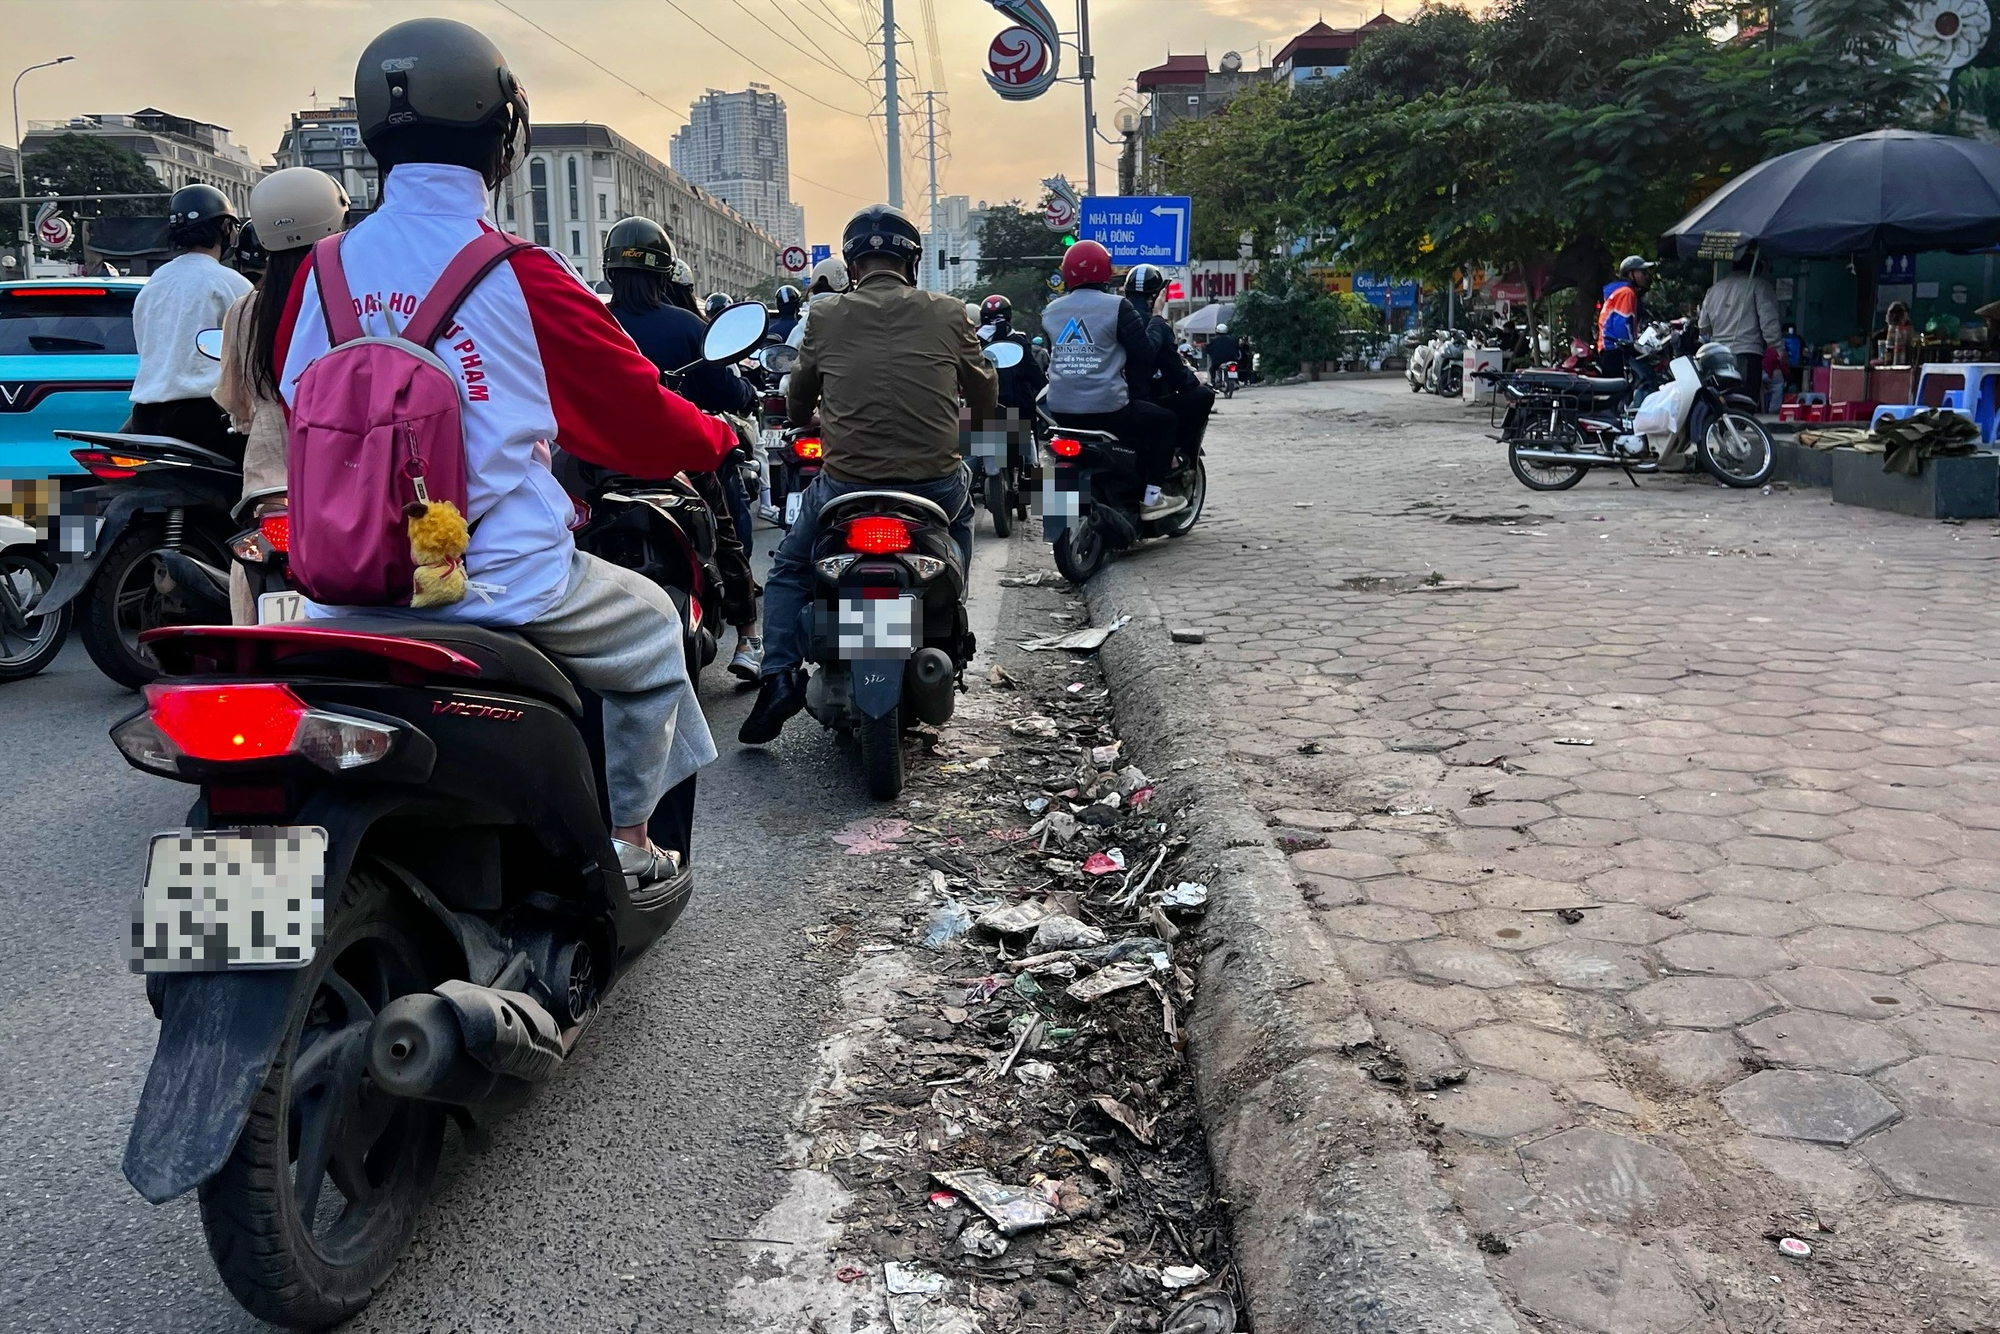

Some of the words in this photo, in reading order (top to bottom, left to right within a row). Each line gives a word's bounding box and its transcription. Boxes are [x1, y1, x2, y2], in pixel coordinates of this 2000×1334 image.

[388, 111, 413, 124] GRS
[1089, 210, 1108, 225] NHÀ
[1109, 213, 1123, 225] THI
[1124, 208, 1143, 225] ĐẤU
[1095, 228, 1108, 242] HÀ
[1110, 228, 1135, 243] ĐÔNG
[1114, 244, 1138, 256] Indoor
[1139, 244, 1171, 256] Stadium
[389, 292, 417, 319] HỌ
[441, 320, 464, 340] Ư
[453, 338, 490, 401] PHẠM
[1056, 346, 1079, 354] MINH
[1080, 346, 1095, 354] AN
[432, 700, 524, 722] VISION
